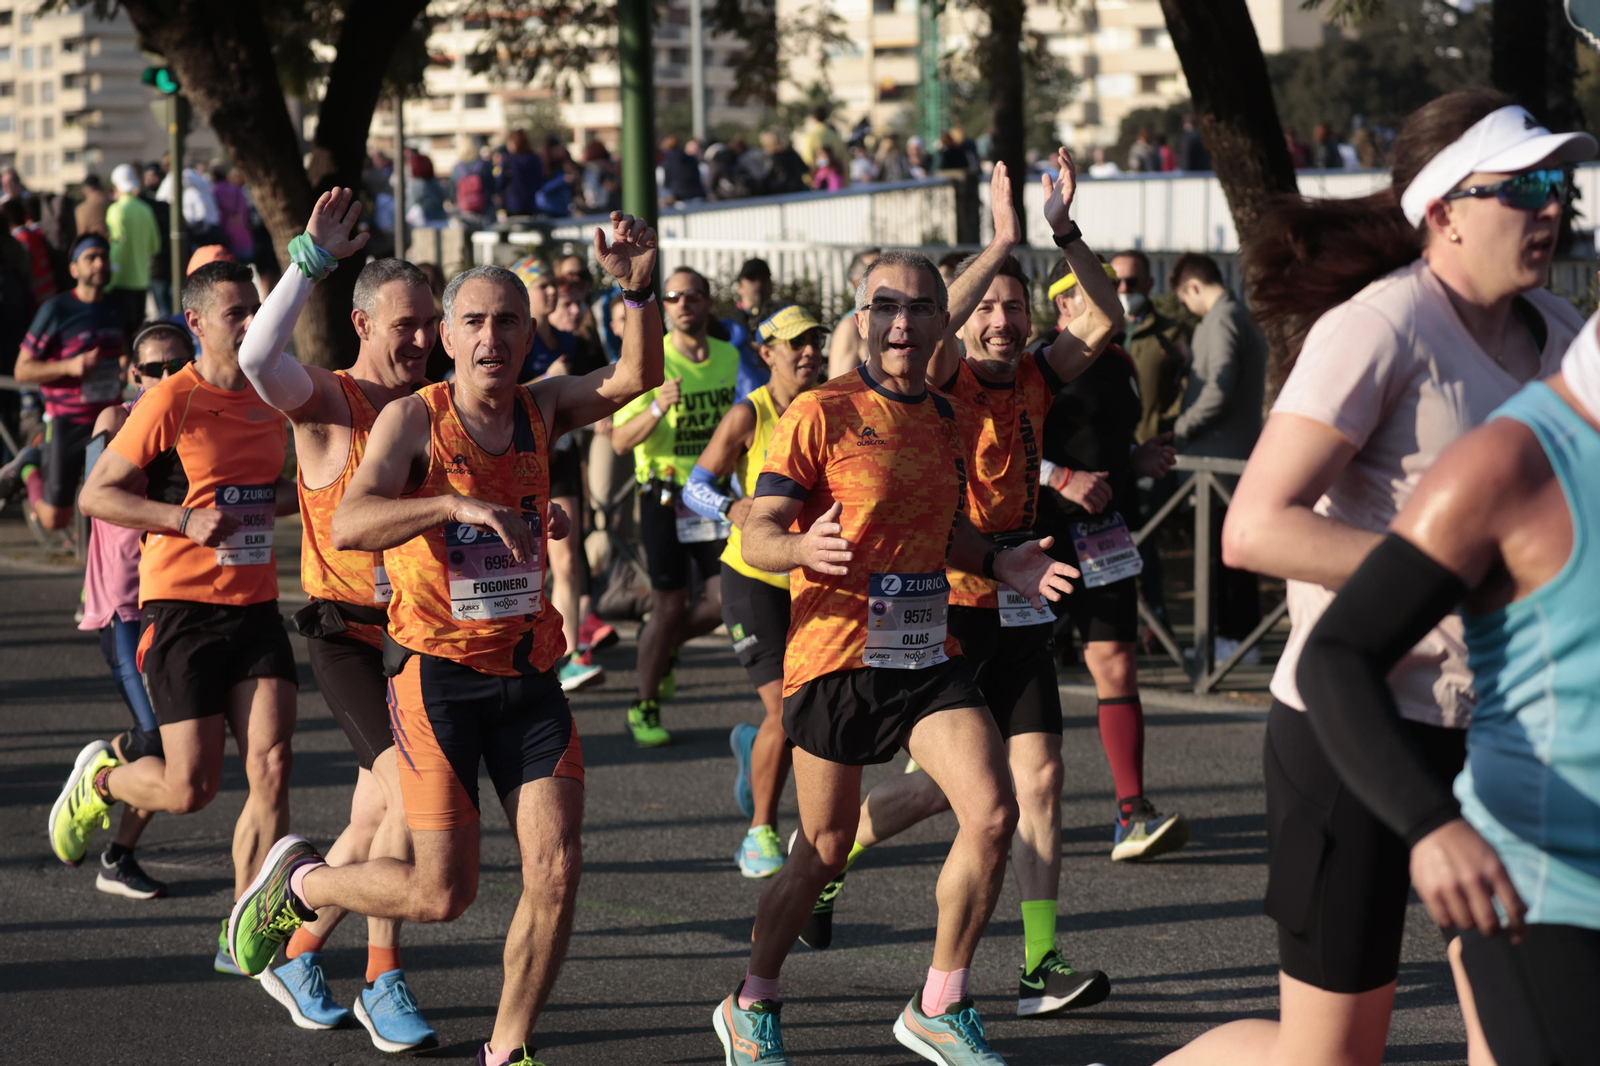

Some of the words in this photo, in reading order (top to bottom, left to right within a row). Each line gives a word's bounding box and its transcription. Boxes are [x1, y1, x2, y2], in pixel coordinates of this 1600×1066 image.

[676, 386, 736, 412] FUTUR
[243, 489, 274, 500] ZURICH
[245, 534, 266, 545] ELKIN
[484, 555, 516, 571] 6952
[473, 577, 528, 594] FOGONERO
[905, 576, 946, 592] ZURICH
[903, 608, 932, 624] 9575
[902, 632, 929, 645] OLIAS
